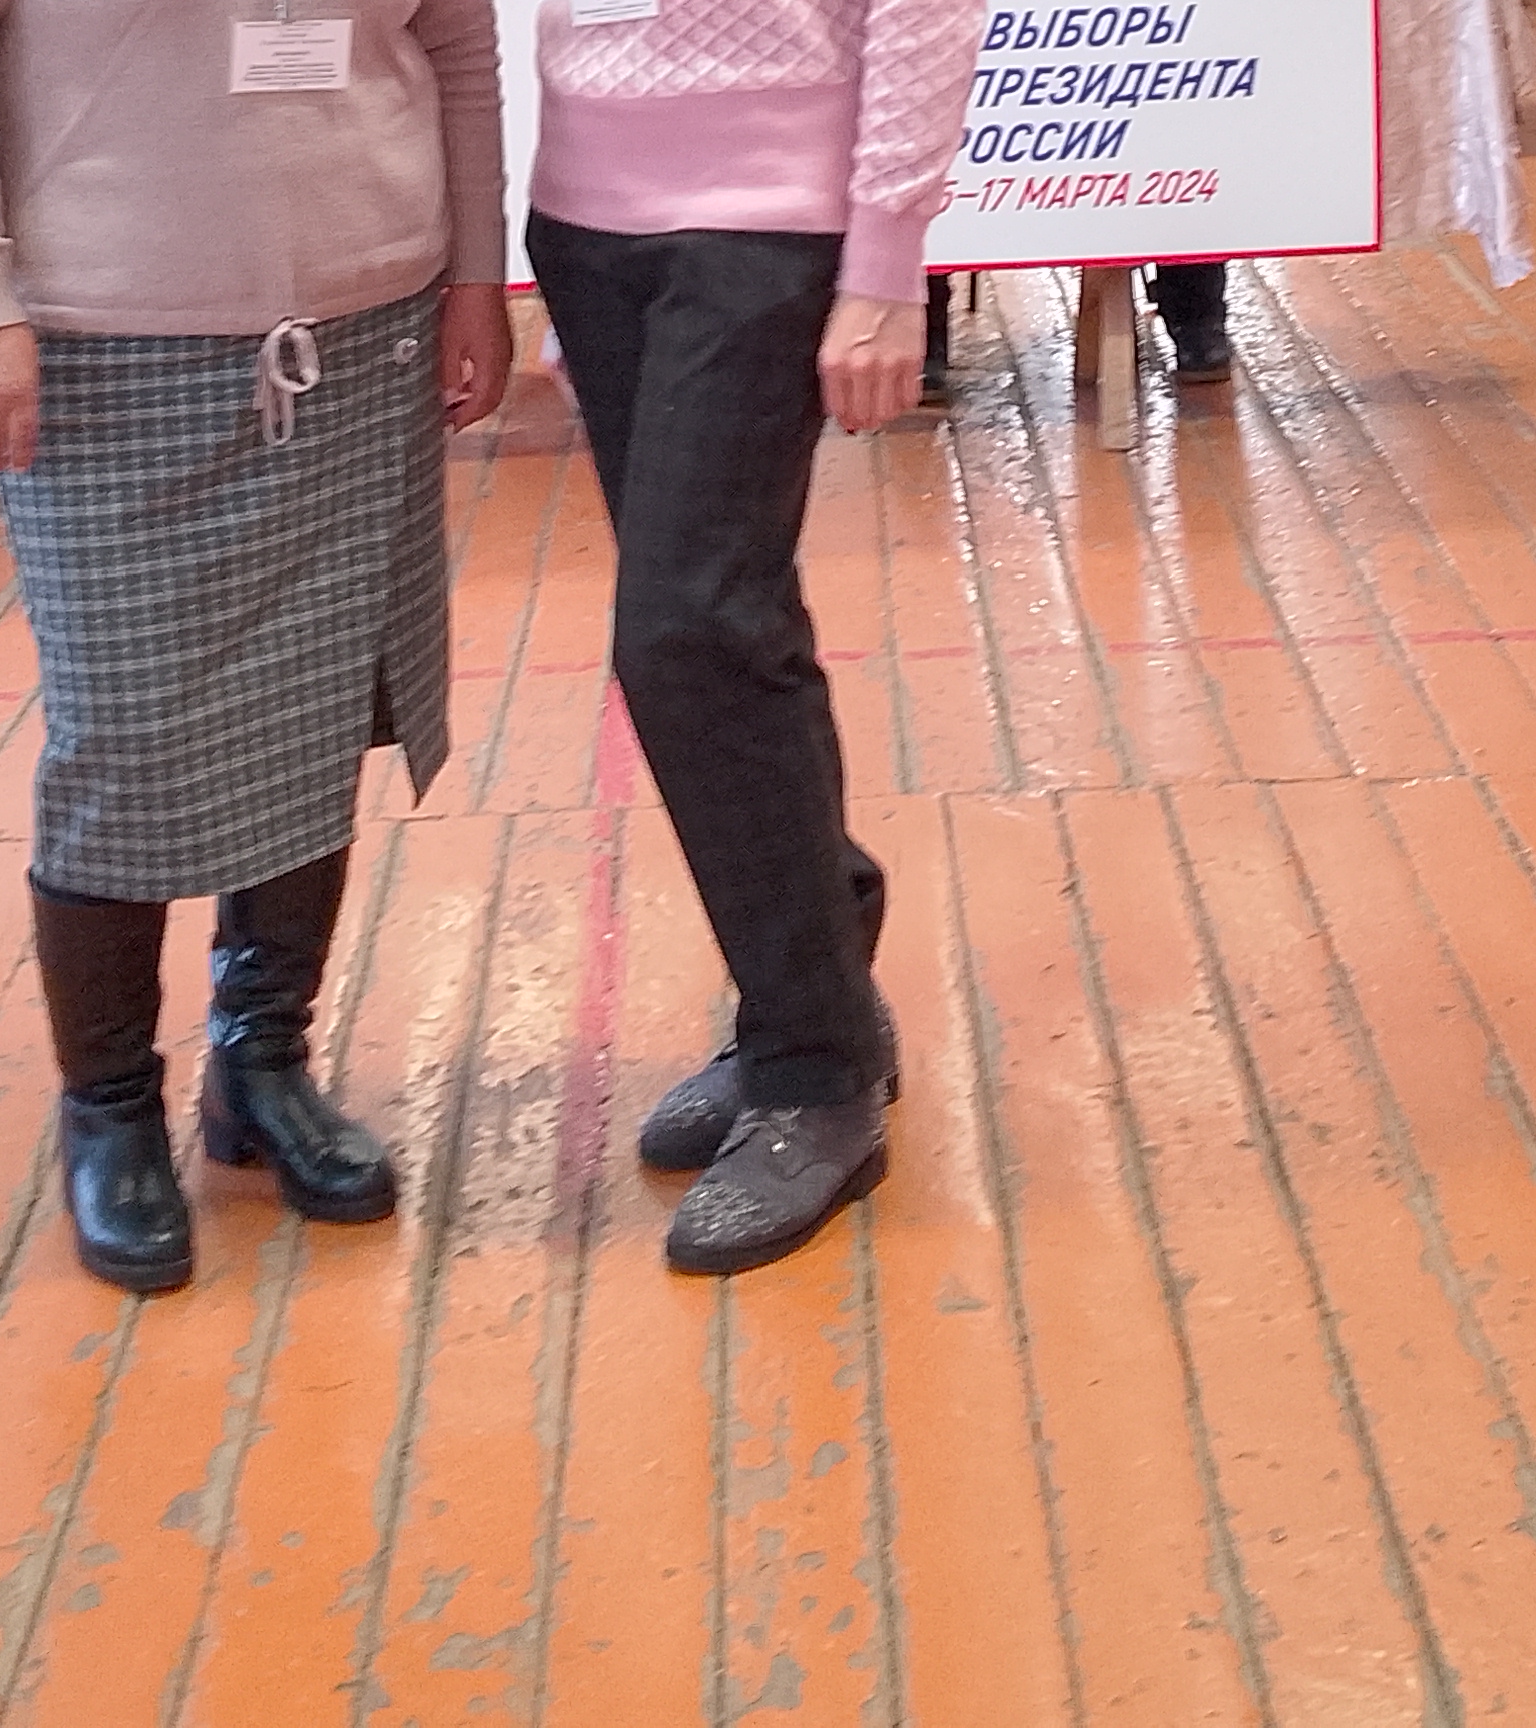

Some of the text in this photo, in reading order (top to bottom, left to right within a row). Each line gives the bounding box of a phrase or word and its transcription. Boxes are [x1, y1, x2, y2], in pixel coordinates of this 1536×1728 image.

[981, 4, 1198, 51] ВЫБОРЫ
[974, 57, 1260, 110] ПРЕЗИДЕНТА
[939, 168, 1220, 214] 5–17 МАРТА 2024
